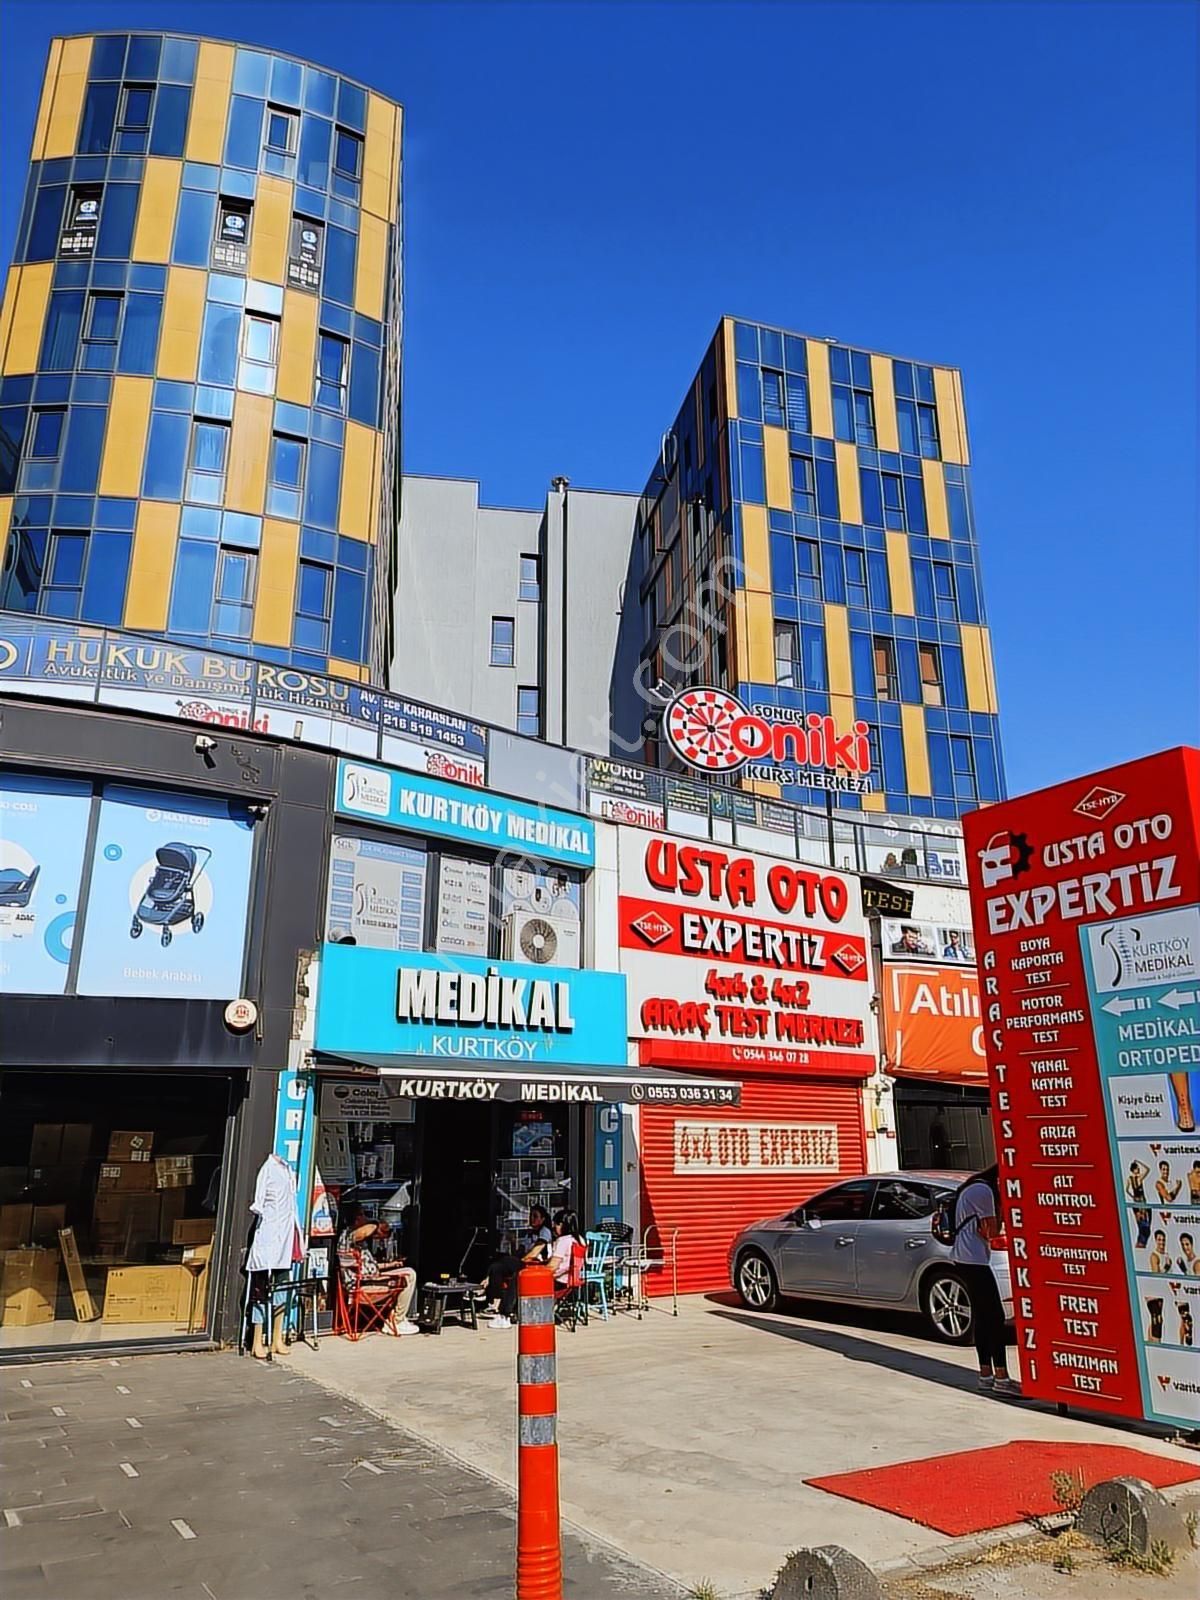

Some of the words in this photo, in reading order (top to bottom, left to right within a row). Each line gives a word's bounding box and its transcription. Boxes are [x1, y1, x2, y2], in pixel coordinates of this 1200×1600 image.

[46, 638, 190, 675] HUKUK
[144, 671, 165, 684] ve
[289, 690, 351, 715] Hizmeti
[436, 728, 465, 747] 1453
[746, 764, 795, 784] KURS
[400, 788, 502, 834] KURTKÖY
[507, 812, 592, 855] MEDİKAL
[1043, 831, 1106, 868] USTA
[1113, 813, 1173, 849] OTO
[645, 839, 756, 908] USTA
[767, 864, 849, 922] OTO
[1020, 936, 1050, 952] BOYA
[1132, 937, 1190, 958] KURTKÖY
[1011, 951, 1064, 971] KAPORTA
[1025, 971, 1052, 985] TEST
[397, 966, 576, 1031] MEDİKAL
[706, 969, 747, 1000] 4x4
[750, 974, 768, 1004] &
[772, 978, 811, 1009] 4x2
[1021, 995, 1063, 1010] MOTOR
[640, 998, 710, 1039] ARAÇ
[715, 1005, 770, 1037] TEST
[1006, 1010, 1084, 1030] PERFORMANS
[1032, 1030, 1059, 1044] TEST
[1118, 1016, 1200, 1042] MEDİKAL
[432, 1034, 537, 1060] KURTKÖY
[743, 1049, 765, 1060] 0544
[786, 1052, 797, 1063] 07
[983, 950, 1003, 1051] ARAÇ
[995, 1064, 1016, 1167] TEST
[1030, 1060, 1070, 1074] YANAL
[400, 1078, 500, 1100] KURTKÖY
[520, 1081, 604, 1102] MEDİKAL
[648, 1086, 677, 1099] 0553
[680, 1087, 701, 1100] 036
[702, 1088, 717, 1100] 31
[719, 1088, 733, 1101] 34
[1031, 1076, 1073, 1091] KAYMA
[1039, 1095, 1068, 1108] TEST
[1039, 1126, 1076, 1140] ARIZA
[679, 1125, 713, 1165] 4x4
[600, 1106, 618, 1223] CİH
[1053, 1175, 1075, 1189] ALT
[1037, 1192, 1097, 1208] KONTROL
[1053, 1212, 1083, 1226] TEST
[1062, 1263, 1087, 1276] TEST
[1059, 1294, 1099, 1315] FREN
[1063, 1318, 1099, 1338] TEST
[1071, 1373, 1102, 1391] TEST
